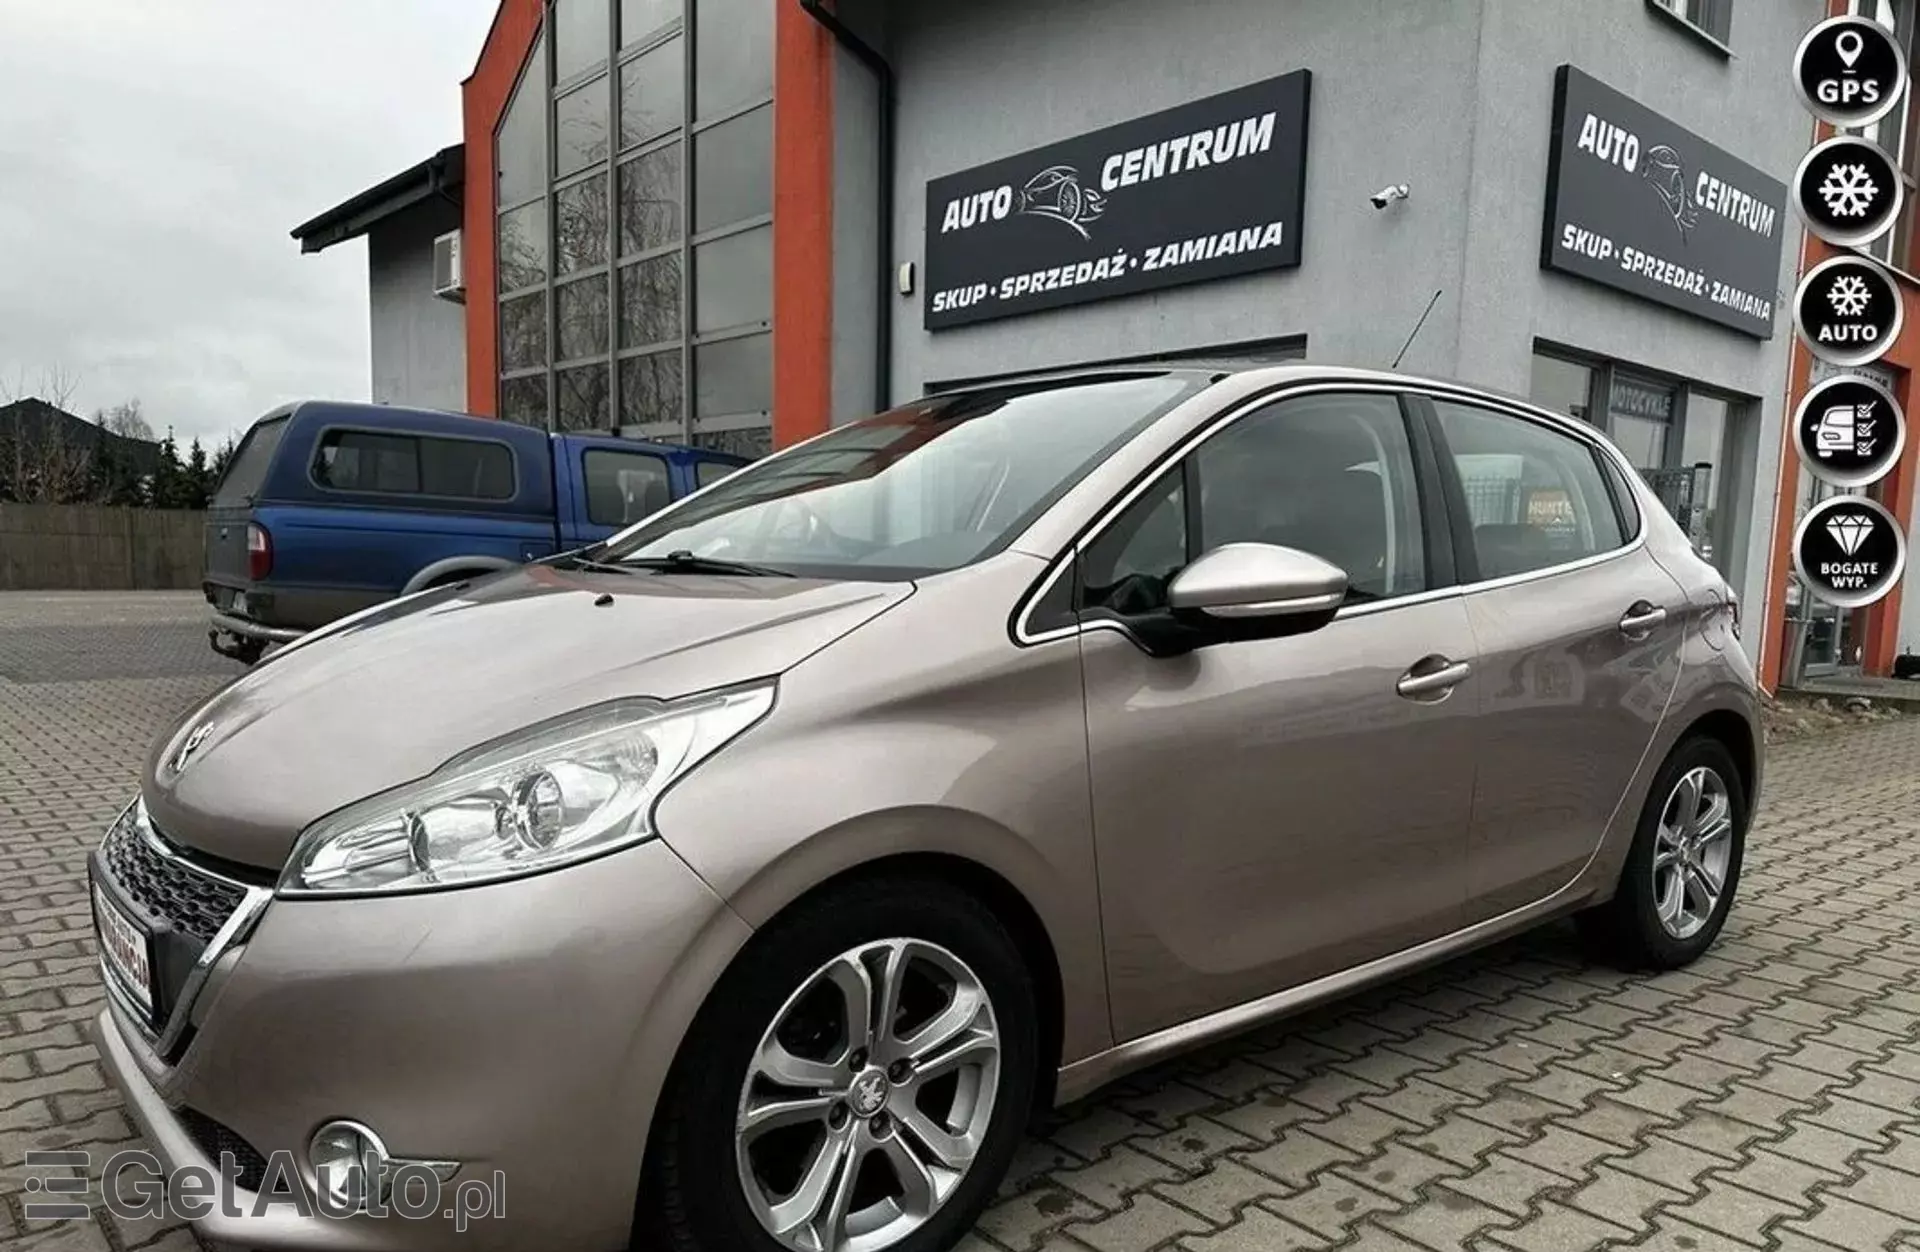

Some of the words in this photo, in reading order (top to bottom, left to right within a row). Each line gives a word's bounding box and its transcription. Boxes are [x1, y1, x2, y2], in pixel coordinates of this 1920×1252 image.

[942, 186, 1012, 234] AUTO
[1101, 112, 1277, 192] CENTRUM
[1577, 113, 1640, 173] AUTO
[1696, 172, 1775, 238] CENTRUM
[932, 283, 988, 312] SKUP
[999, 248, 1128, 299] SPRZEDAŻ
[1142, 222, 1283, 271] ZAMIANA
[1561, 224, 1612, 261] SKUP
[1710, 281, 1771, 321] ZAMIANA
